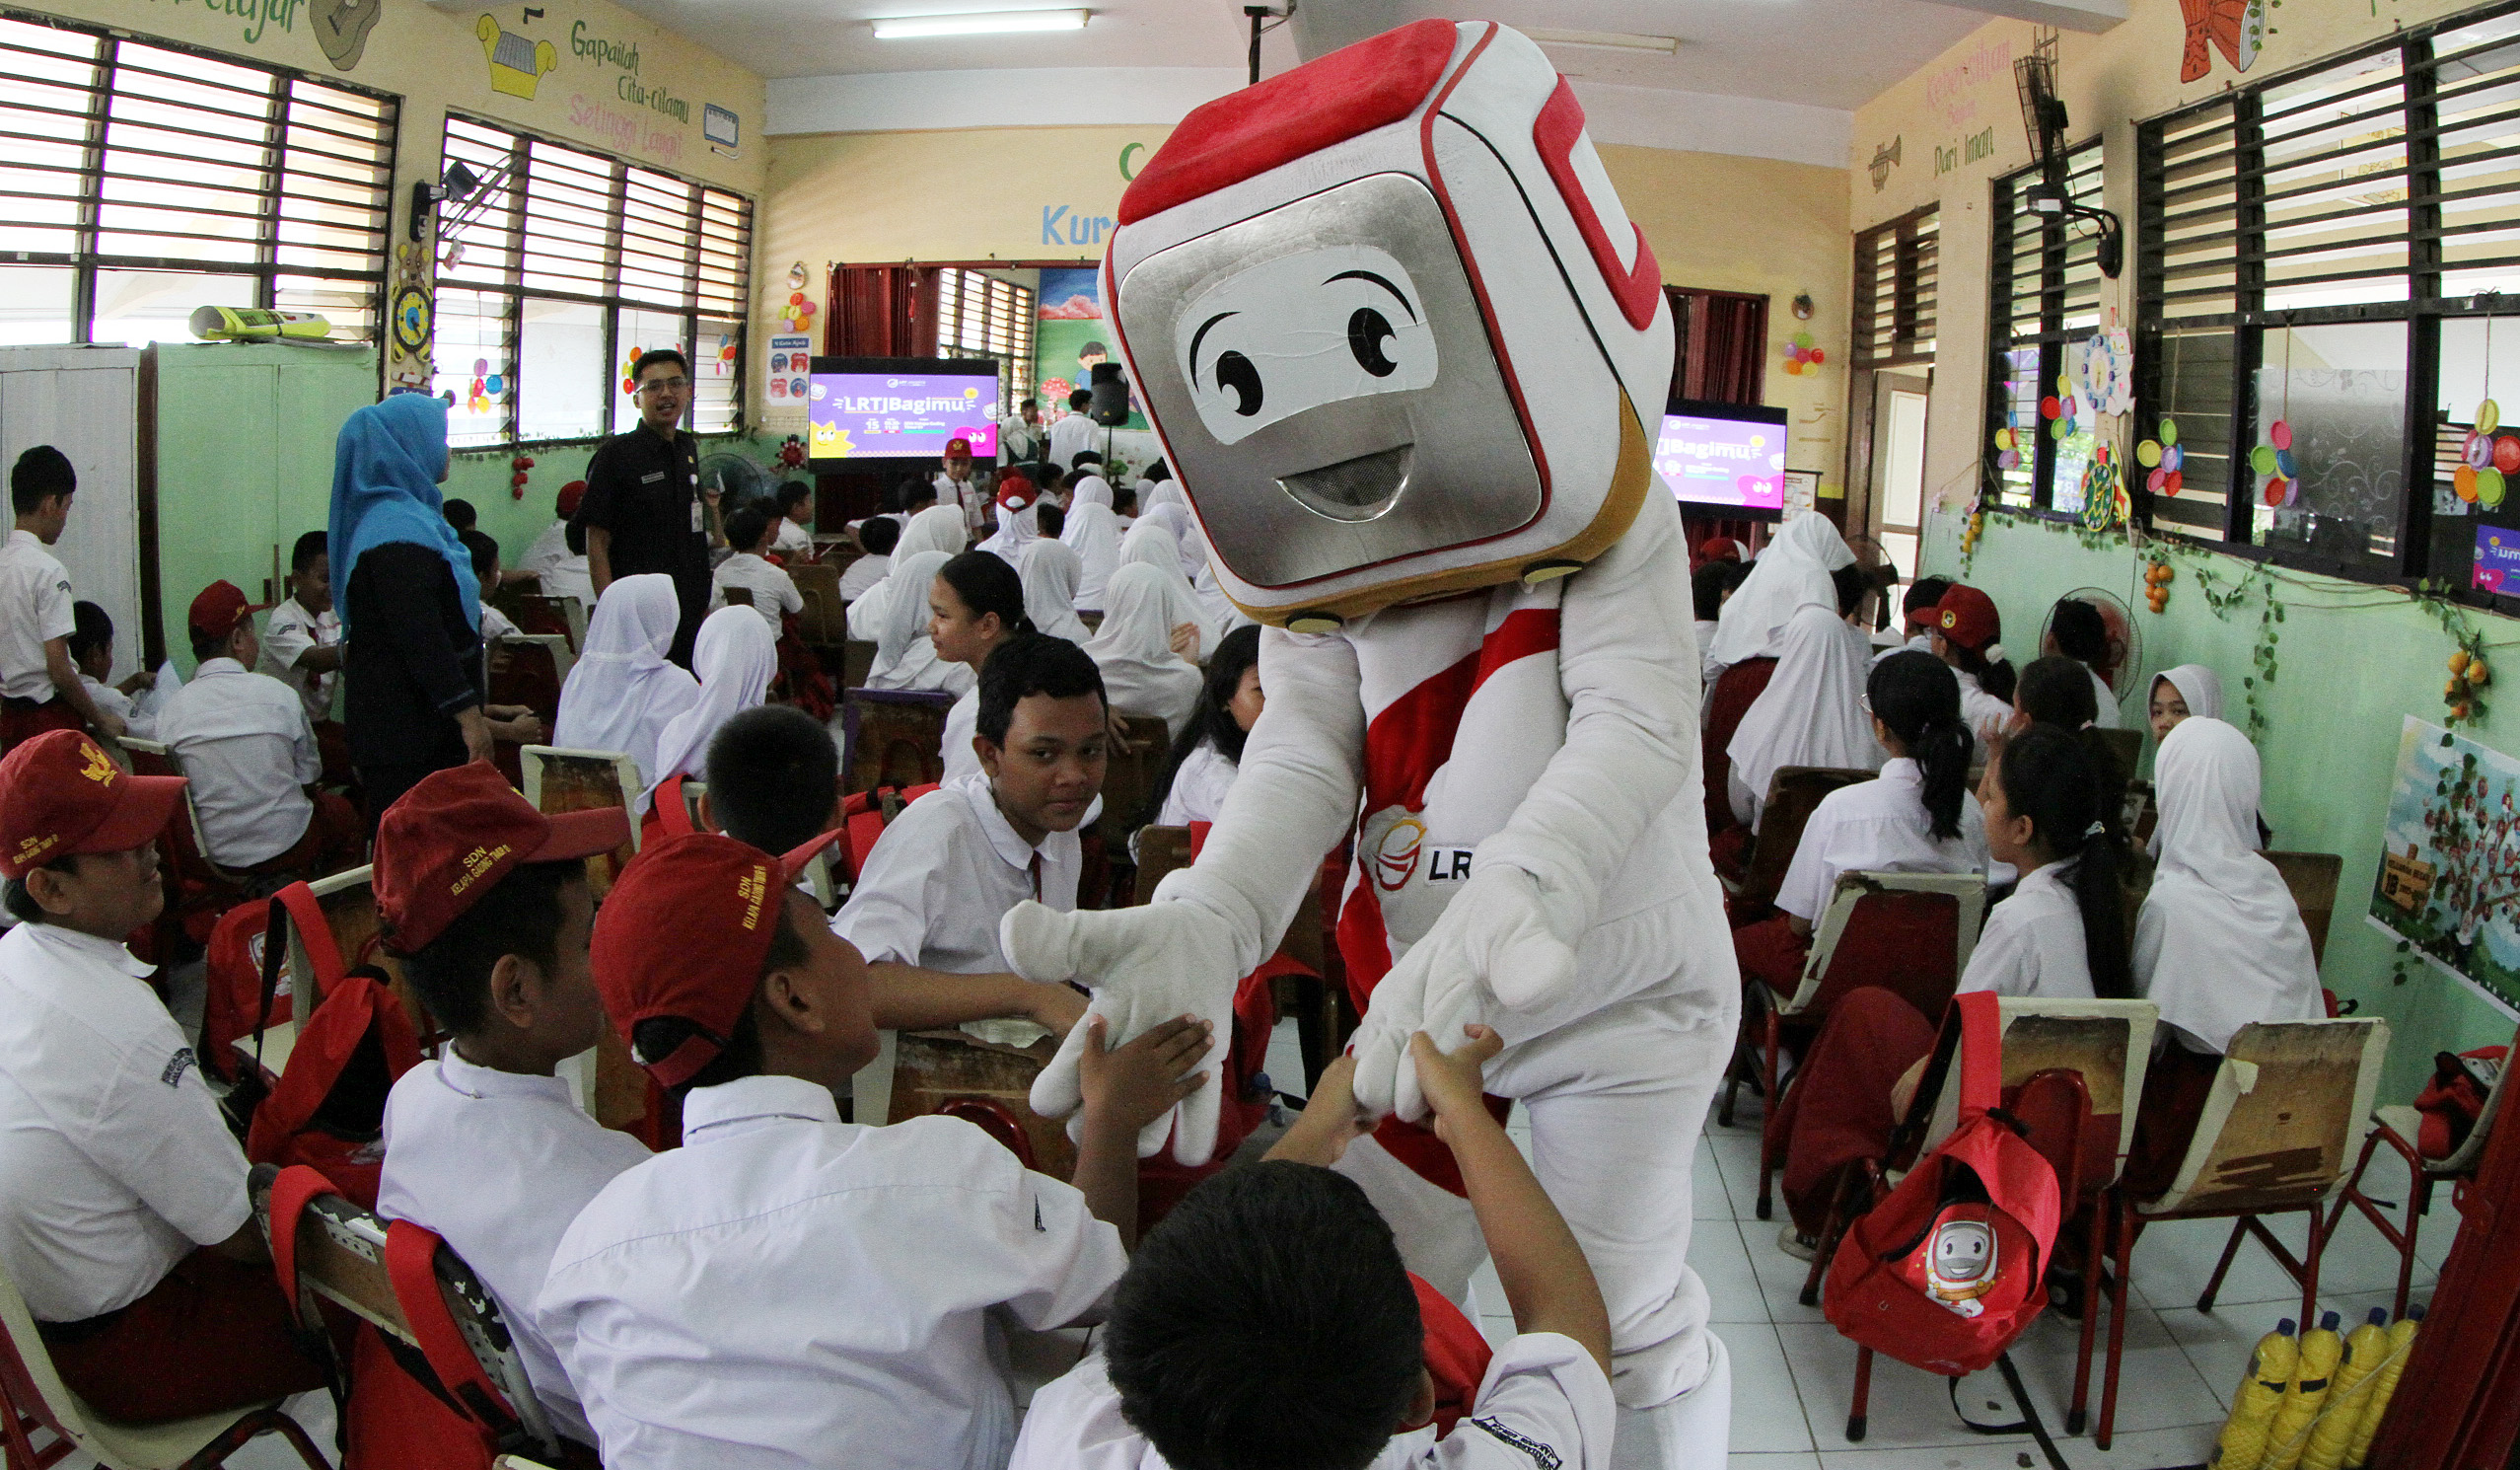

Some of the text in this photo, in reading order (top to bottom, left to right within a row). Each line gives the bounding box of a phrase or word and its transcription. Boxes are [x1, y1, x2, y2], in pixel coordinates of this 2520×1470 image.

[1934, 125, 1994, 181] Dari Iman
[1042, 205, 1120, 246] Kur
[844, 397, 966, 414] LRTJBagimu
[865, 420, 880, 430] 15
[463, 845, 487, 868] SDN
[737, 875, 753, 900] SDN
